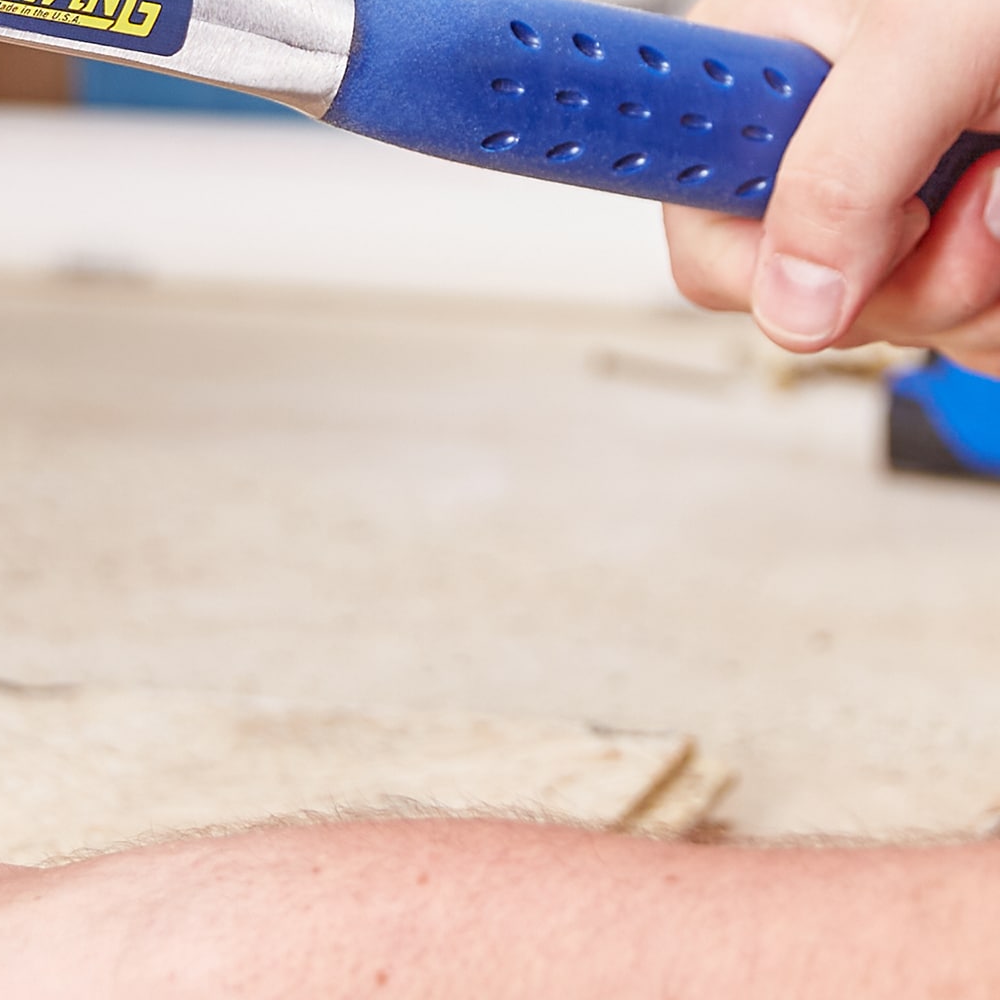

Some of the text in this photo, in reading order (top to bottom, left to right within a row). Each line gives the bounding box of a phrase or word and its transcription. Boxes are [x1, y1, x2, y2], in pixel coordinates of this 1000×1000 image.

[20, 5, 31, 15] in
[33, 8, 50, 18] the
[51, 11, 81, 24] U.S.A.
